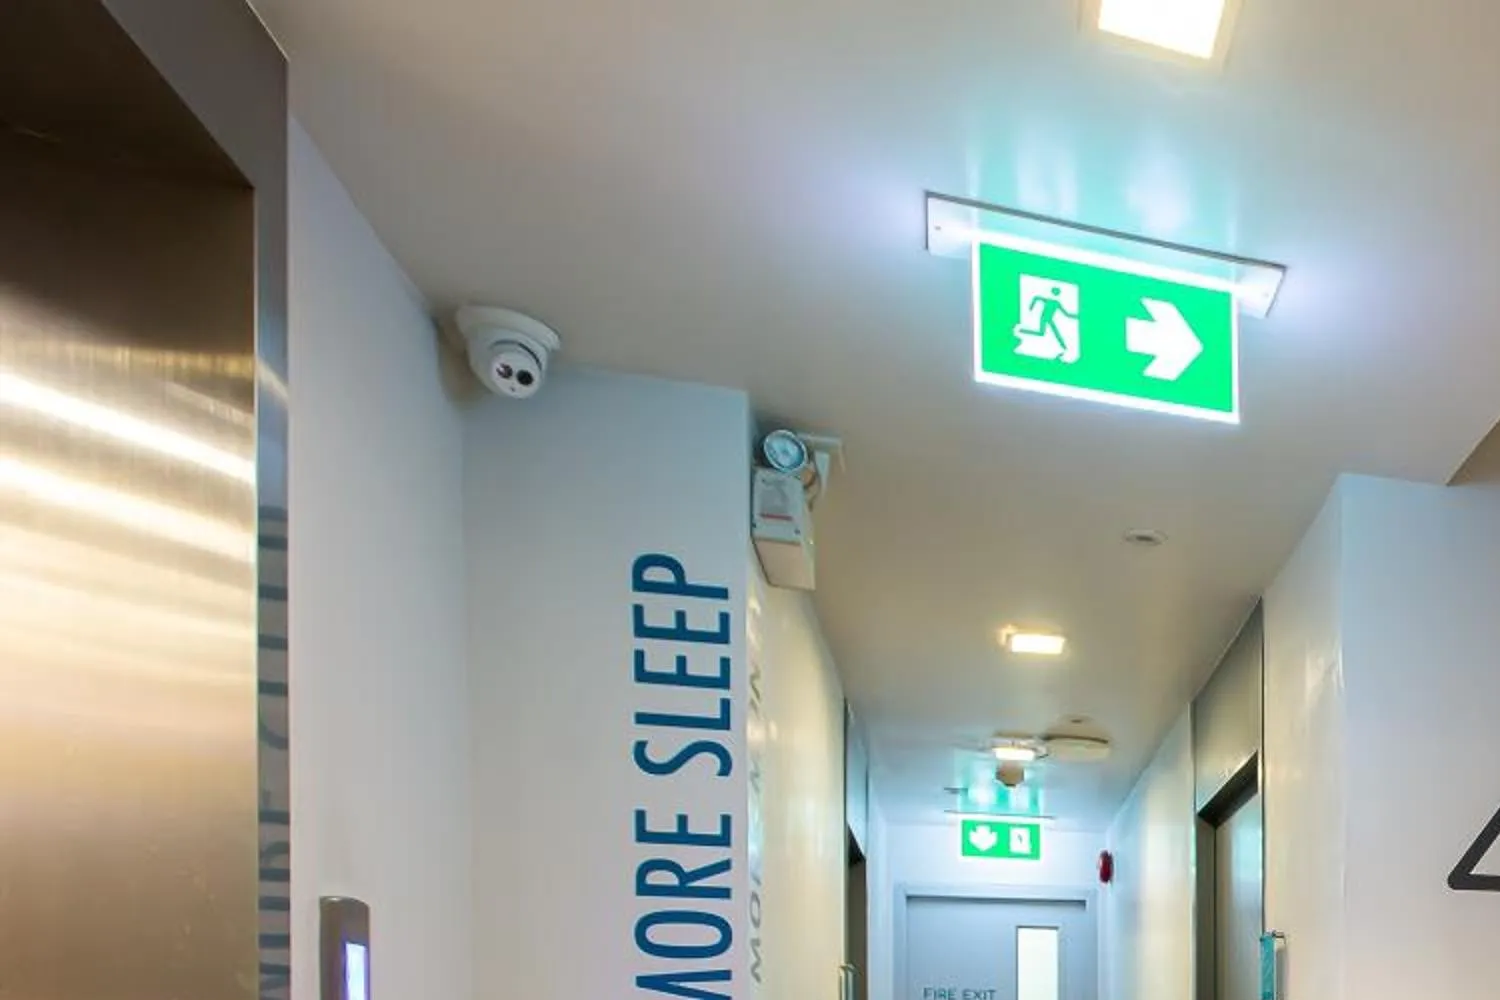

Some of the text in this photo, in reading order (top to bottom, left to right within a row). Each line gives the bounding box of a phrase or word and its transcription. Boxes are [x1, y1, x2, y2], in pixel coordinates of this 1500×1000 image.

[631, 552, 733, 778] SLEEP
[923, 987, 997, 1000] FIRE EXIT
